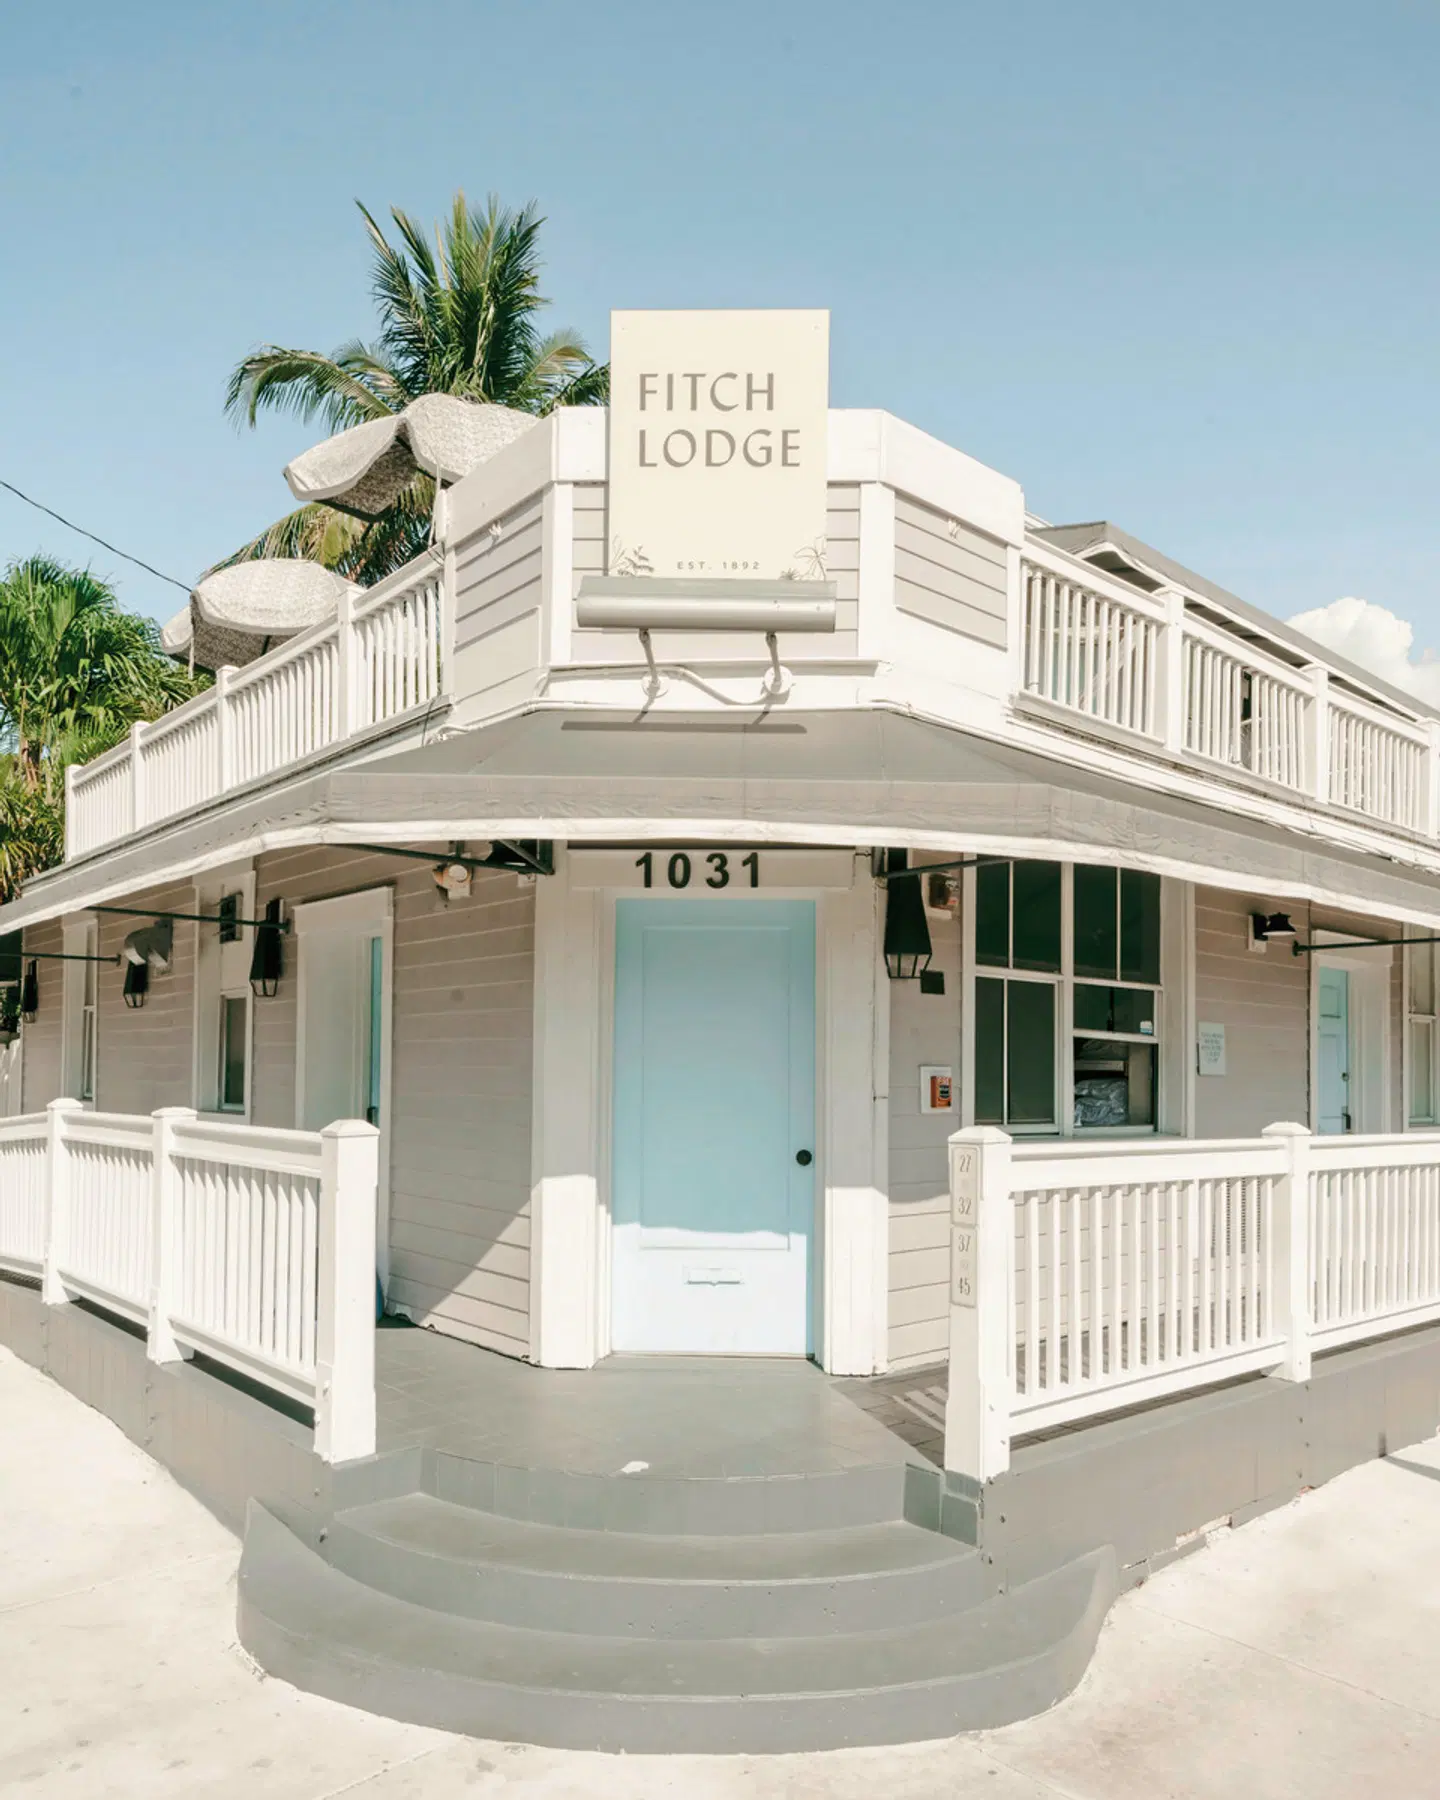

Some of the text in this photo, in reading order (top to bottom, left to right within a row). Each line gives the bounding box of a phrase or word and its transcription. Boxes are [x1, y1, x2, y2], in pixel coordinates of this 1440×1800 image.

[638, 371, 774, 412] FITCH
[638, 428, 801, 468] LODGE
[676, 560, 760, 570] EST. 1892
[635, 852, 759, 889] 1031
[959, 1154, 972, 1173] 27
[958, 1196, 972, 1215] 32
[958, 1234, 972, 1252] 37
[958, 1277, 971, 1296] 45
